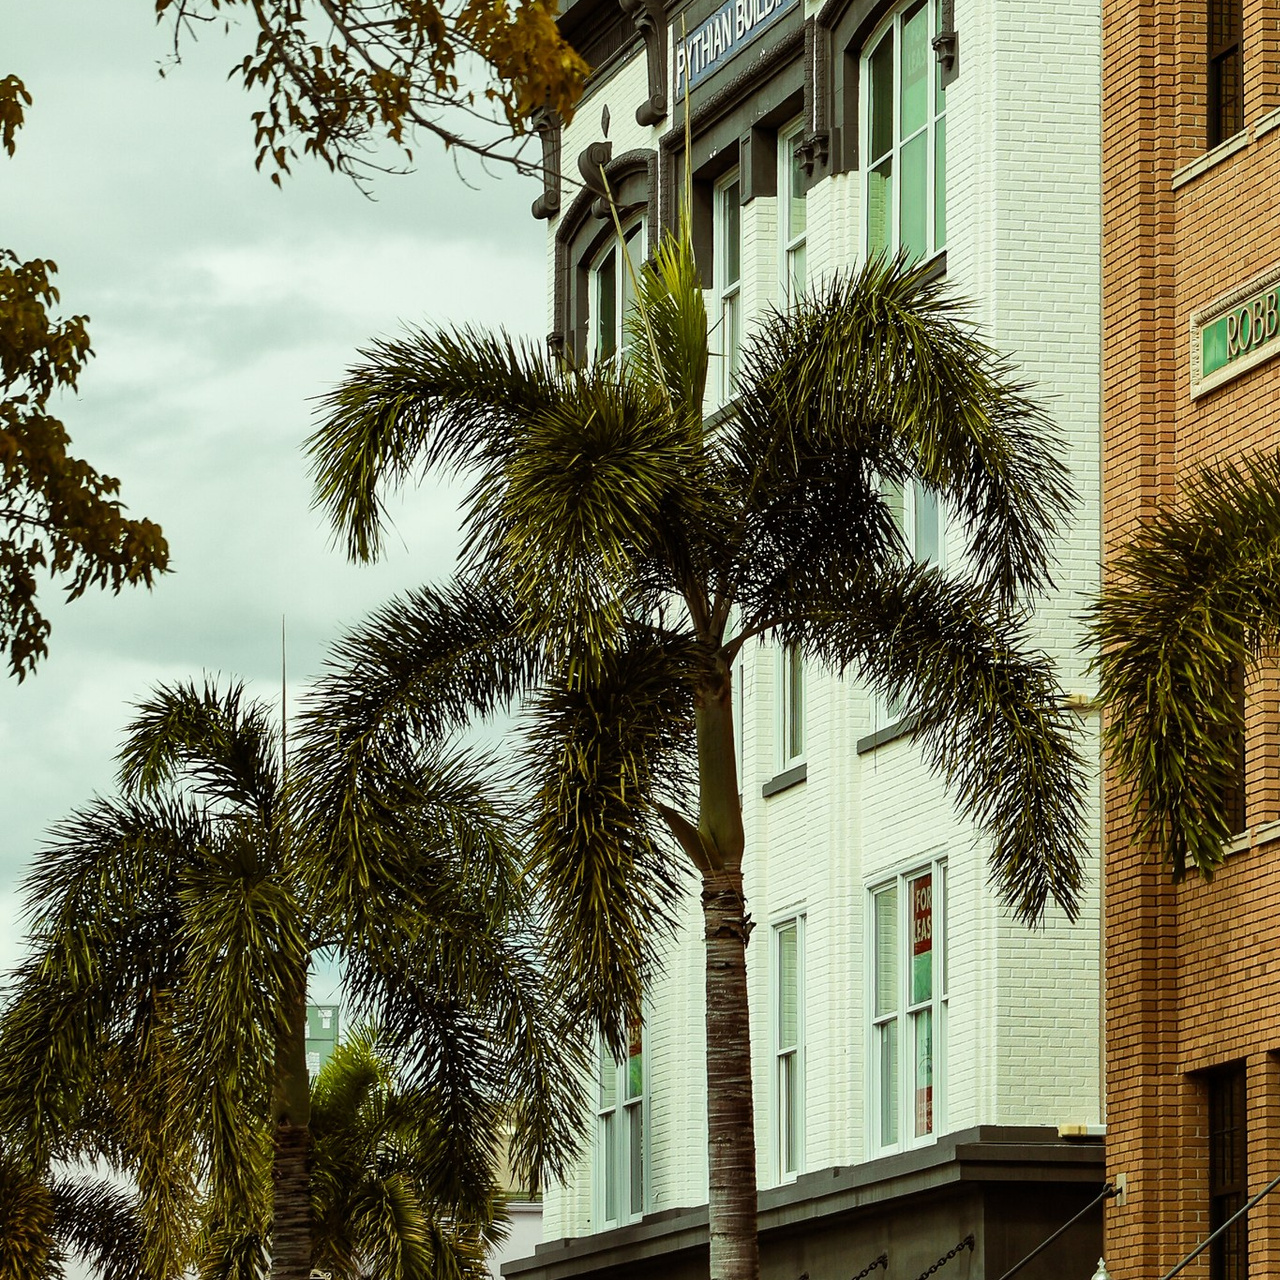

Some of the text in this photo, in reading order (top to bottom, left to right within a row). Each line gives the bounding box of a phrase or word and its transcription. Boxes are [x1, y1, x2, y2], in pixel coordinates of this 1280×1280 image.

[676, 7, 733, 99] PYTHIAN
[1226, 291, 1280, 360] ROBB
[916, 885, 932, 913] FOR
[914, 915, 932, 944] LEAS
